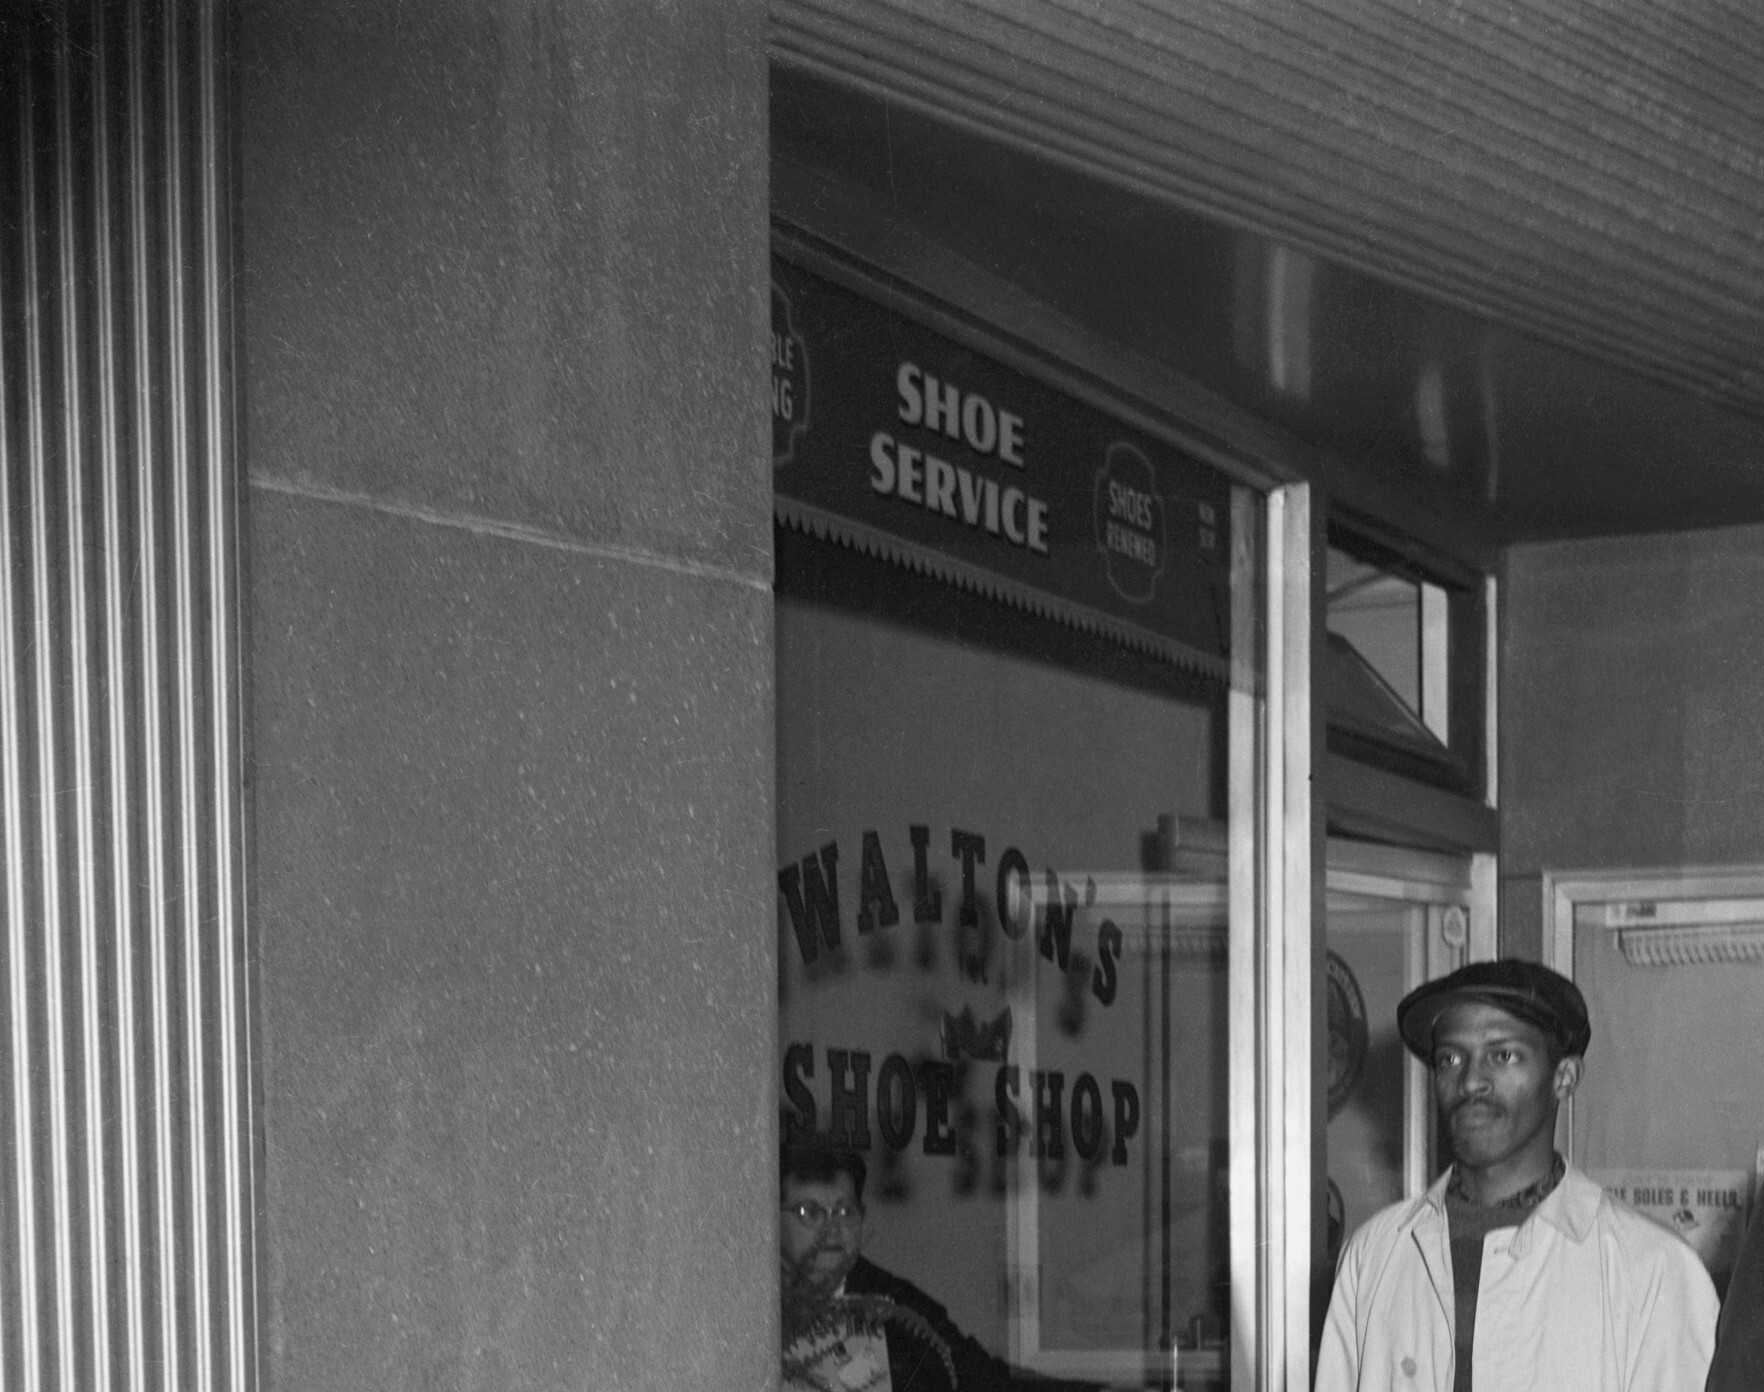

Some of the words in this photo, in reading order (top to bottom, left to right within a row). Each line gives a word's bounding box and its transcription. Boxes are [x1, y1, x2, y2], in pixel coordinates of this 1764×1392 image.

[897, 361, 1024, 468] SHOE
[870, 431, 1048, 552] SERVICE
[1109, 479, 1153, 531] SHOES
[777, 825, 1123, 1007] WALTON'S
[781, 1042, 957, 1157] SHOE
[995, 1065, 1140, 1167] SHOP
